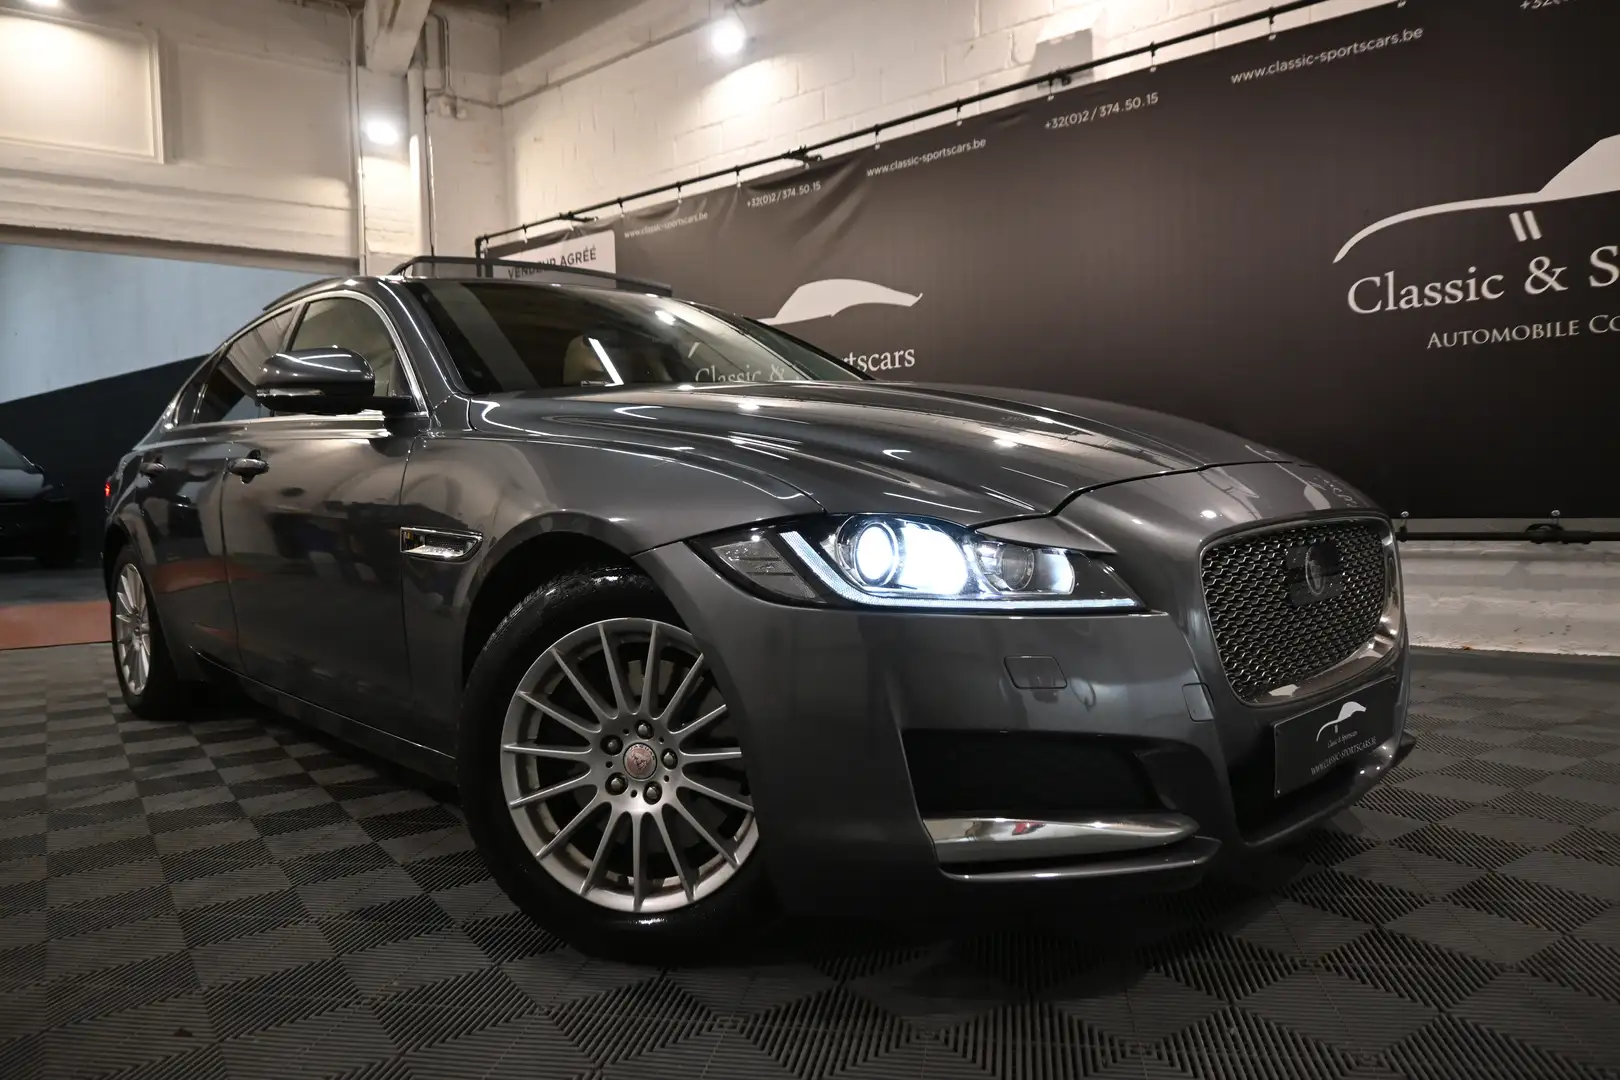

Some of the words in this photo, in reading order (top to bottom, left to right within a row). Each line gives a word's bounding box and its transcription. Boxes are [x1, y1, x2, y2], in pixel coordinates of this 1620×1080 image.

[1231, 25, 1424, 84] www.classic-sportscars.be
[866, 137, 986, 177] www.classic-sportscars.be
[624, 211, 708, 239] www.classic-sportscars.be
[560, 244, 597, 267] AGRÉÉ
[1347, 266, 1505, 314] Classic
[1524, 256, 1569, 295] &
[1427, 319, 1580, 349] AUTOMOBILE
